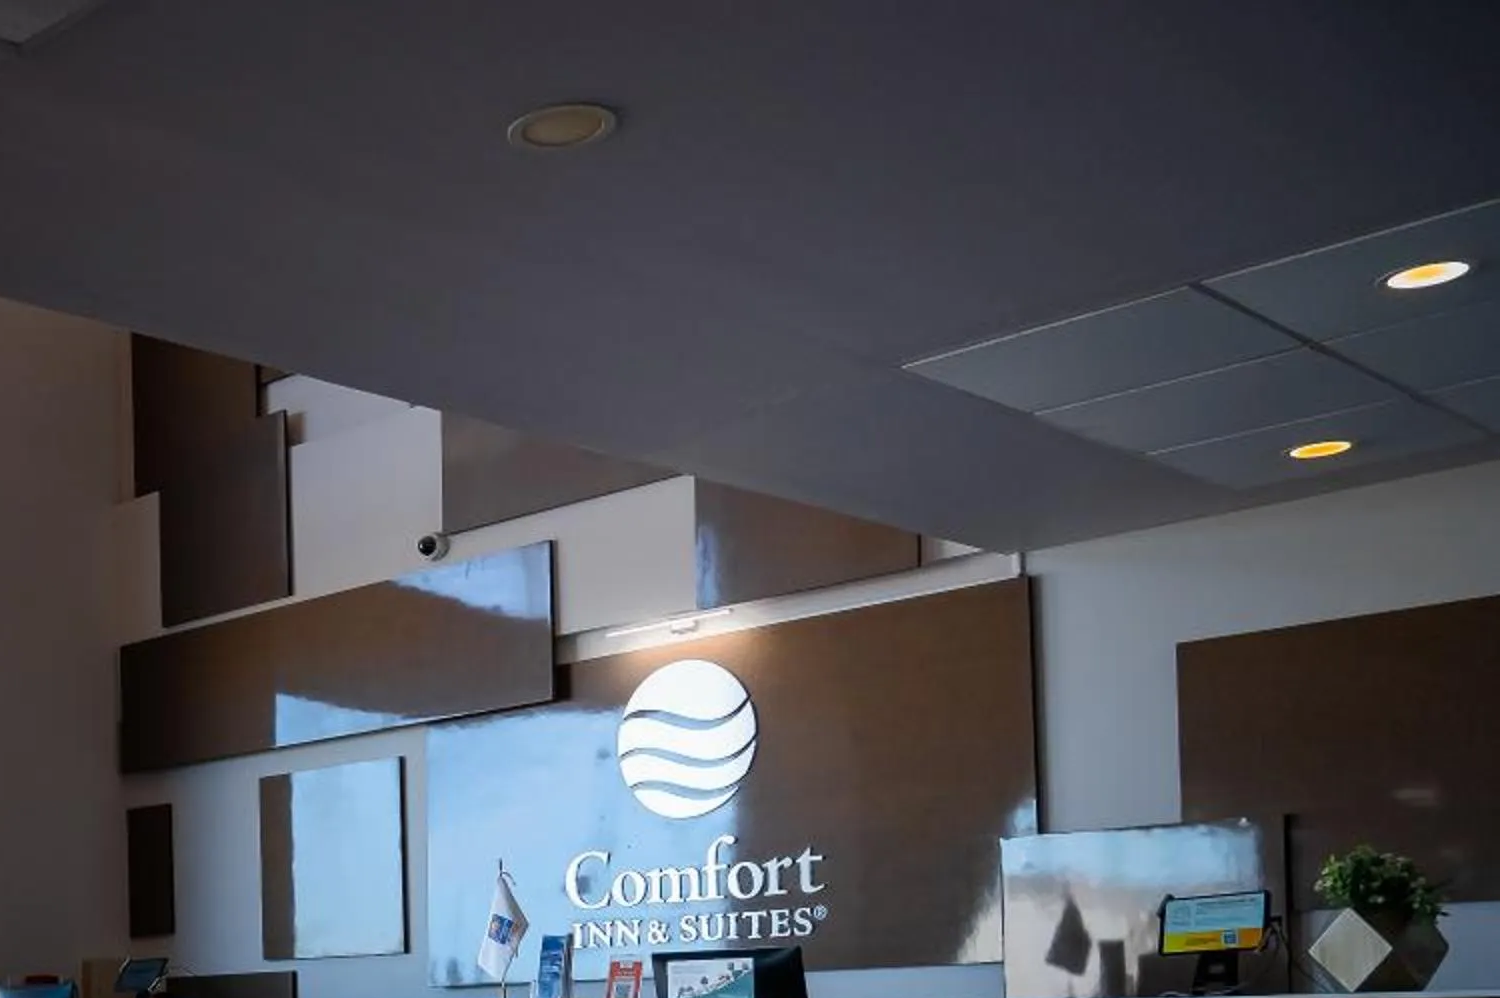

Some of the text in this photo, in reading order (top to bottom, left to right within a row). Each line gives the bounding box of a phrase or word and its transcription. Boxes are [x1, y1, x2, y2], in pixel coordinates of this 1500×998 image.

[565, 835, 827, 909] Comfort
[572, 919, 643, 949] INN
[648, 919, 669, 944] &
